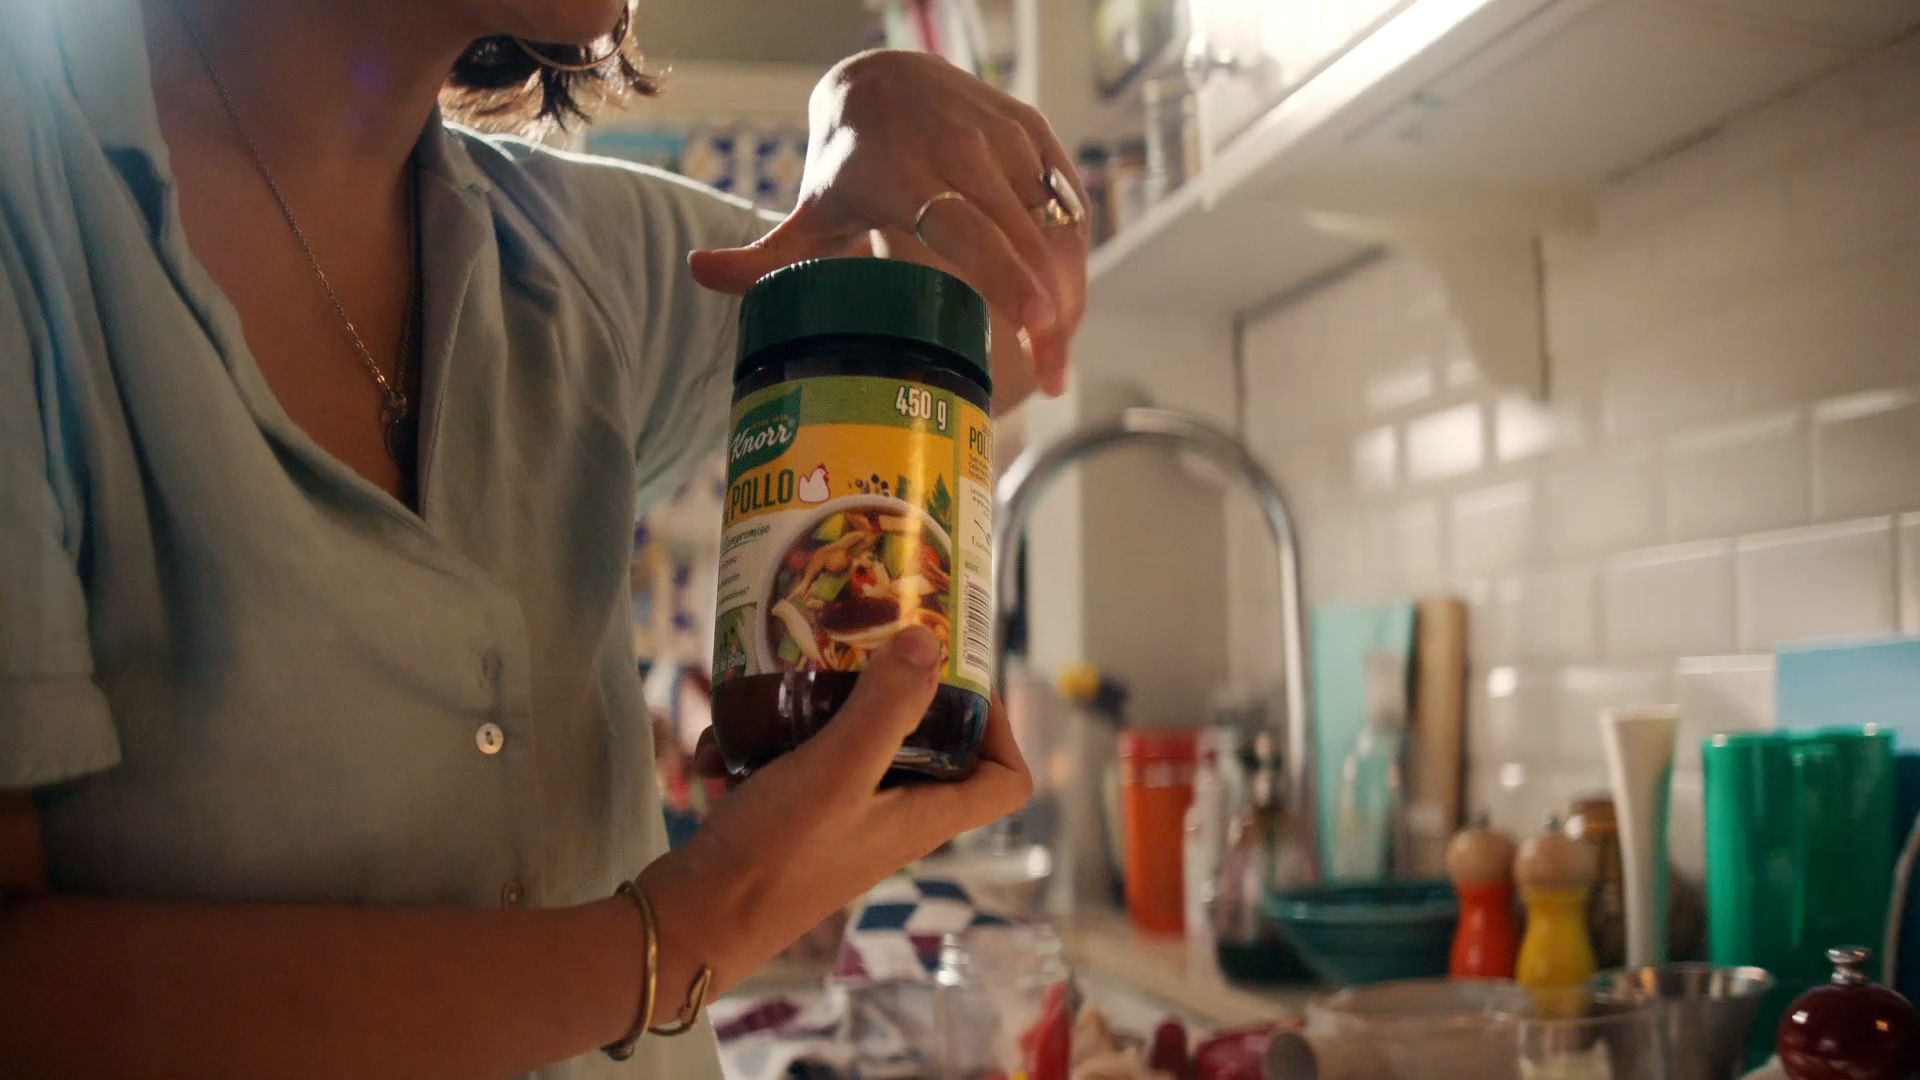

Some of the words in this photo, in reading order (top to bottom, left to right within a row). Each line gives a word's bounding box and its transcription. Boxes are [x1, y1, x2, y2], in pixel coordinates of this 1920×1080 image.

[896, 386, 933, 420] 450
[936, 400, 947, 431] g
[731, 424, 792, 463] Knorr
[731, 469, 794, 521] POLLO
